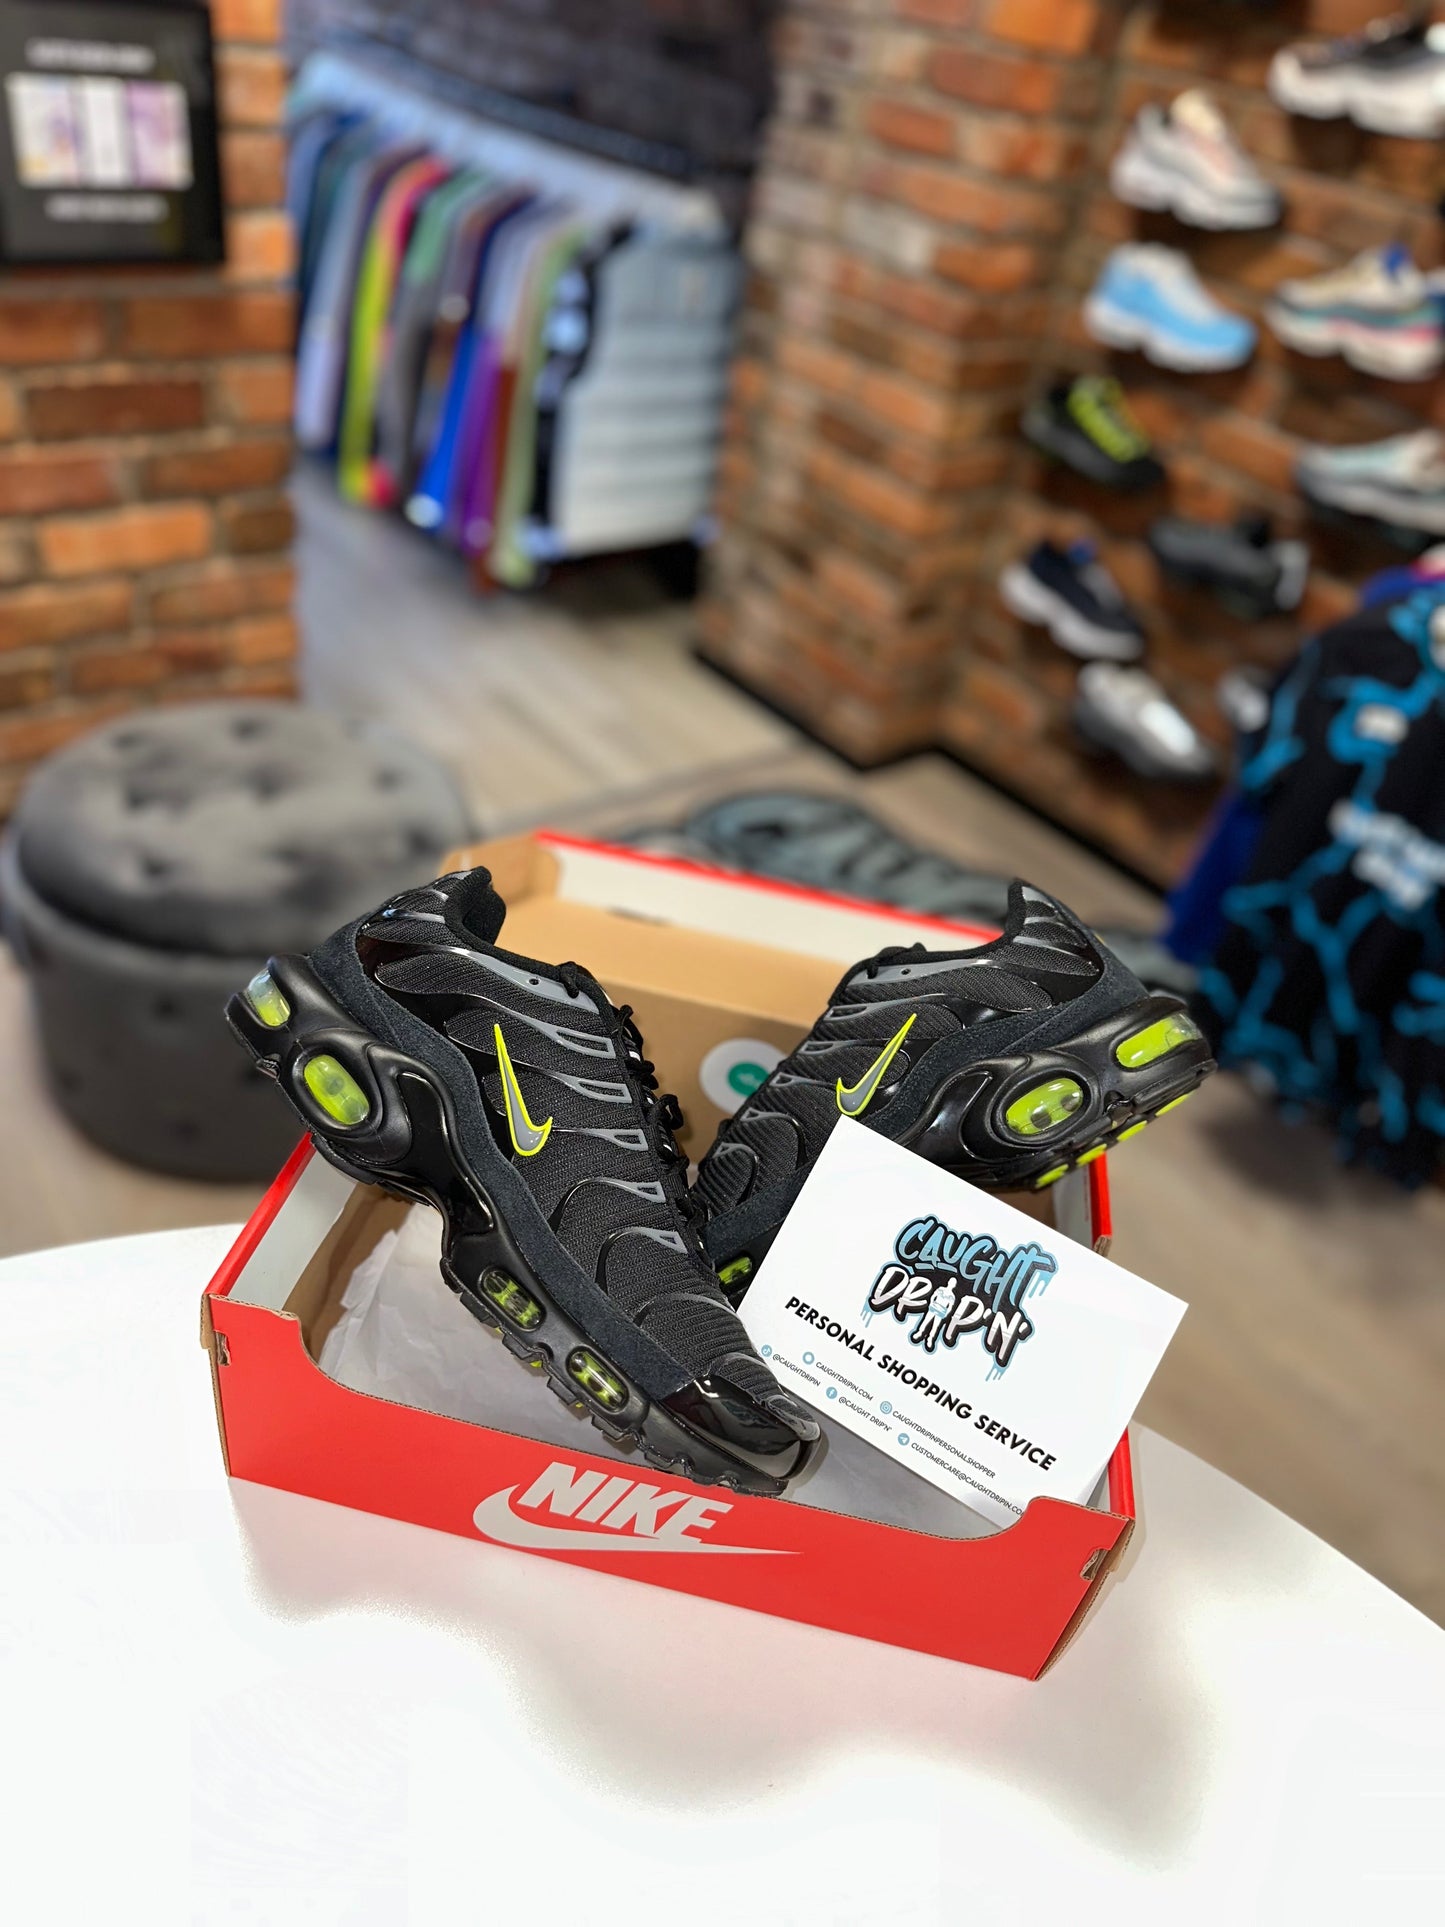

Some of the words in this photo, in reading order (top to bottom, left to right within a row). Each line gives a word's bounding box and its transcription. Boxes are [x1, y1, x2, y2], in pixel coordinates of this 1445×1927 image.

[895, 1216, 1057, 1310] CAUGHT
[772, 1353, 821, 1387] @CAUGHTDRIPIN
[785, 1296, 874, 1363] PERSONAL
[877, 1354, 972, 1420] SHOPPING
[974, 1415, 1057, 1471] SERVICE
[815, 1361, 874, 1401] CAUGHTDRIPIN.COM
[838, 1396, 871, 1419] @CAUGHT
[892, 1410, 996, 1479] CAUGHTDRIPINPERSONALSHOPPER
[517, 1461, 734, 1543] NIKE
